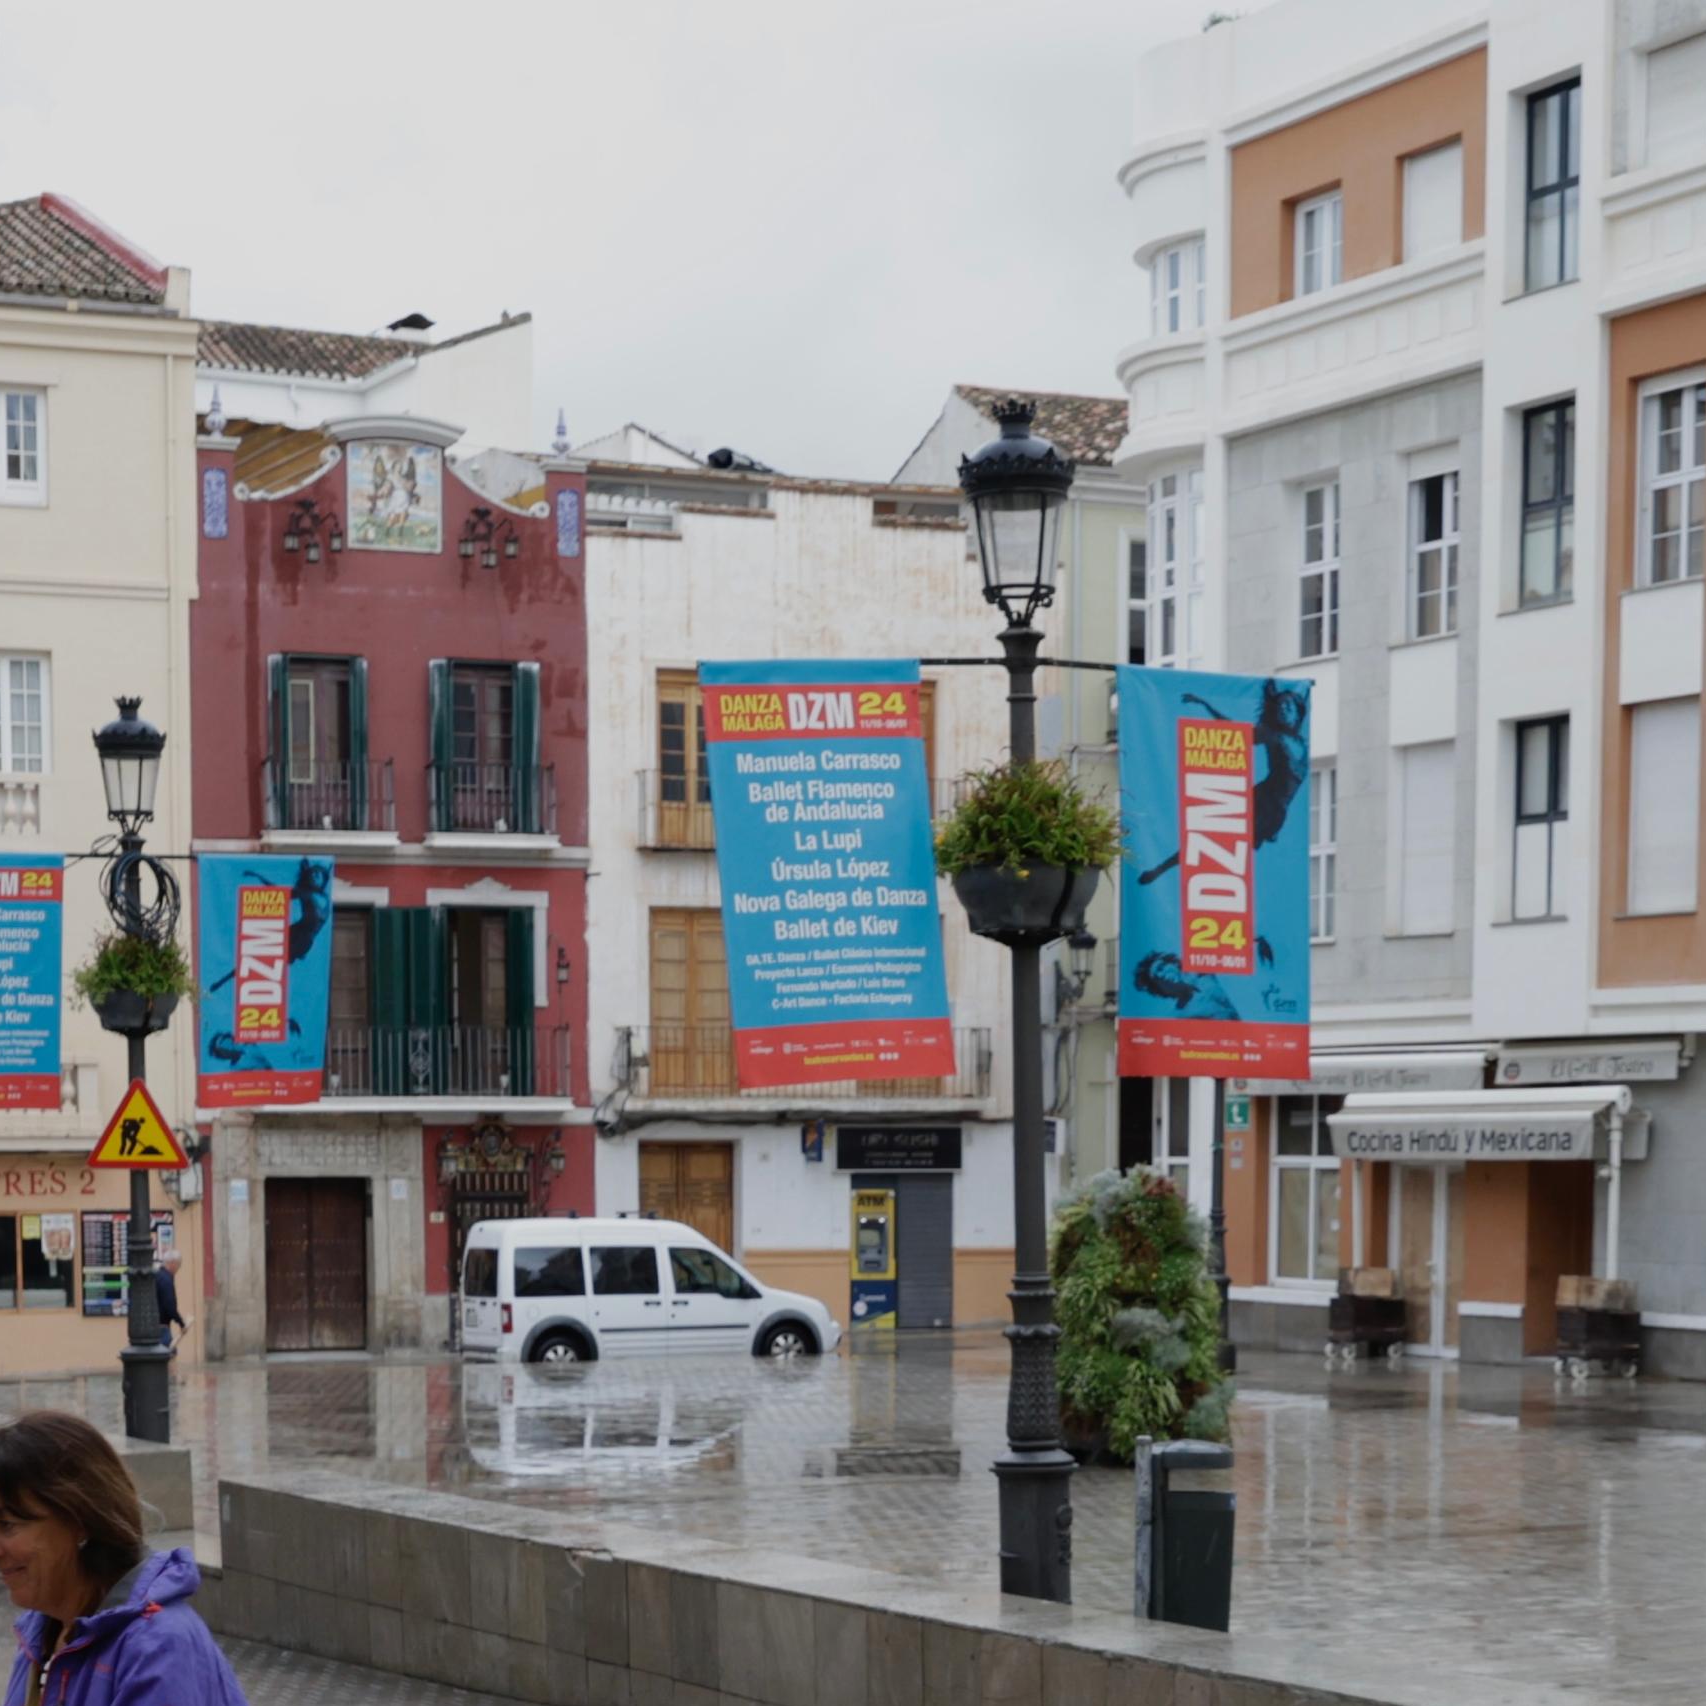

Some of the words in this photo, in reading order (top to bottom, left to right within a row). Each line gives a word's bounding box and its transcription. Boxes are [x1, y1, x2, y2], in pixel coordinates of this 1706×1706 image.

[720, 694, 782, 715] DANZA
[787, 692, 855, 730] DZM
[859, 692, 907, 715] 24
[722, 714, 785, 732] MÁLAGA
[1184, 726, 1246, 751] DANZA
[737, 752, 816, 773] Manuela
[821, 750, 901, 770] Carrasco
[1185, 748, 1246, 770] MÁLAGA
[749, 782, 803, 802] Ballet
[808, 780, 894, 800] Flamenco
[766, 803, 789, 823] de
[794, 800, 884, 822] Andalucía
[795, 831, 816, 850] La
[822, 828, 862, 853] Lupi
[1185, 772, 1248, 913] DZM
[22, 872, 53, 888] 24
[772, 857, 832, 881] Úrsula
[837, 858, 889, 881] López
[243, 890, 285, 905] DANZA
[734, 893, 780, 914] Nova
[785, 890, 846, 912] Galega
[851, 888, 873, 907] de
[877, 886, 927, 906] Danza
[775, 919, 828, 940] Ballet
[834, 917, 857, 936] de
[861, 915, 899, 935] Kiev
[1189, 917, 1246, 950] 24
[239, 919, 286, 1005] DZM
[814, 950, 840, 961] Ballet
[1, 993, 16, 1006] de
[18, 993, 54, 1006] Danza
[5, 1010, 31, 1023] Kiev
[239, 1008, 281, 1028] 24
[1347, 1130, 1403, 1153] Cocina
[1409, 1128, 1458, 1152] Hindú
[1479, 1128, 1572, 1152] Mexicana
[80, 1169, 97, 1195] 2
[857, 1196, 886, 1207] ATM
